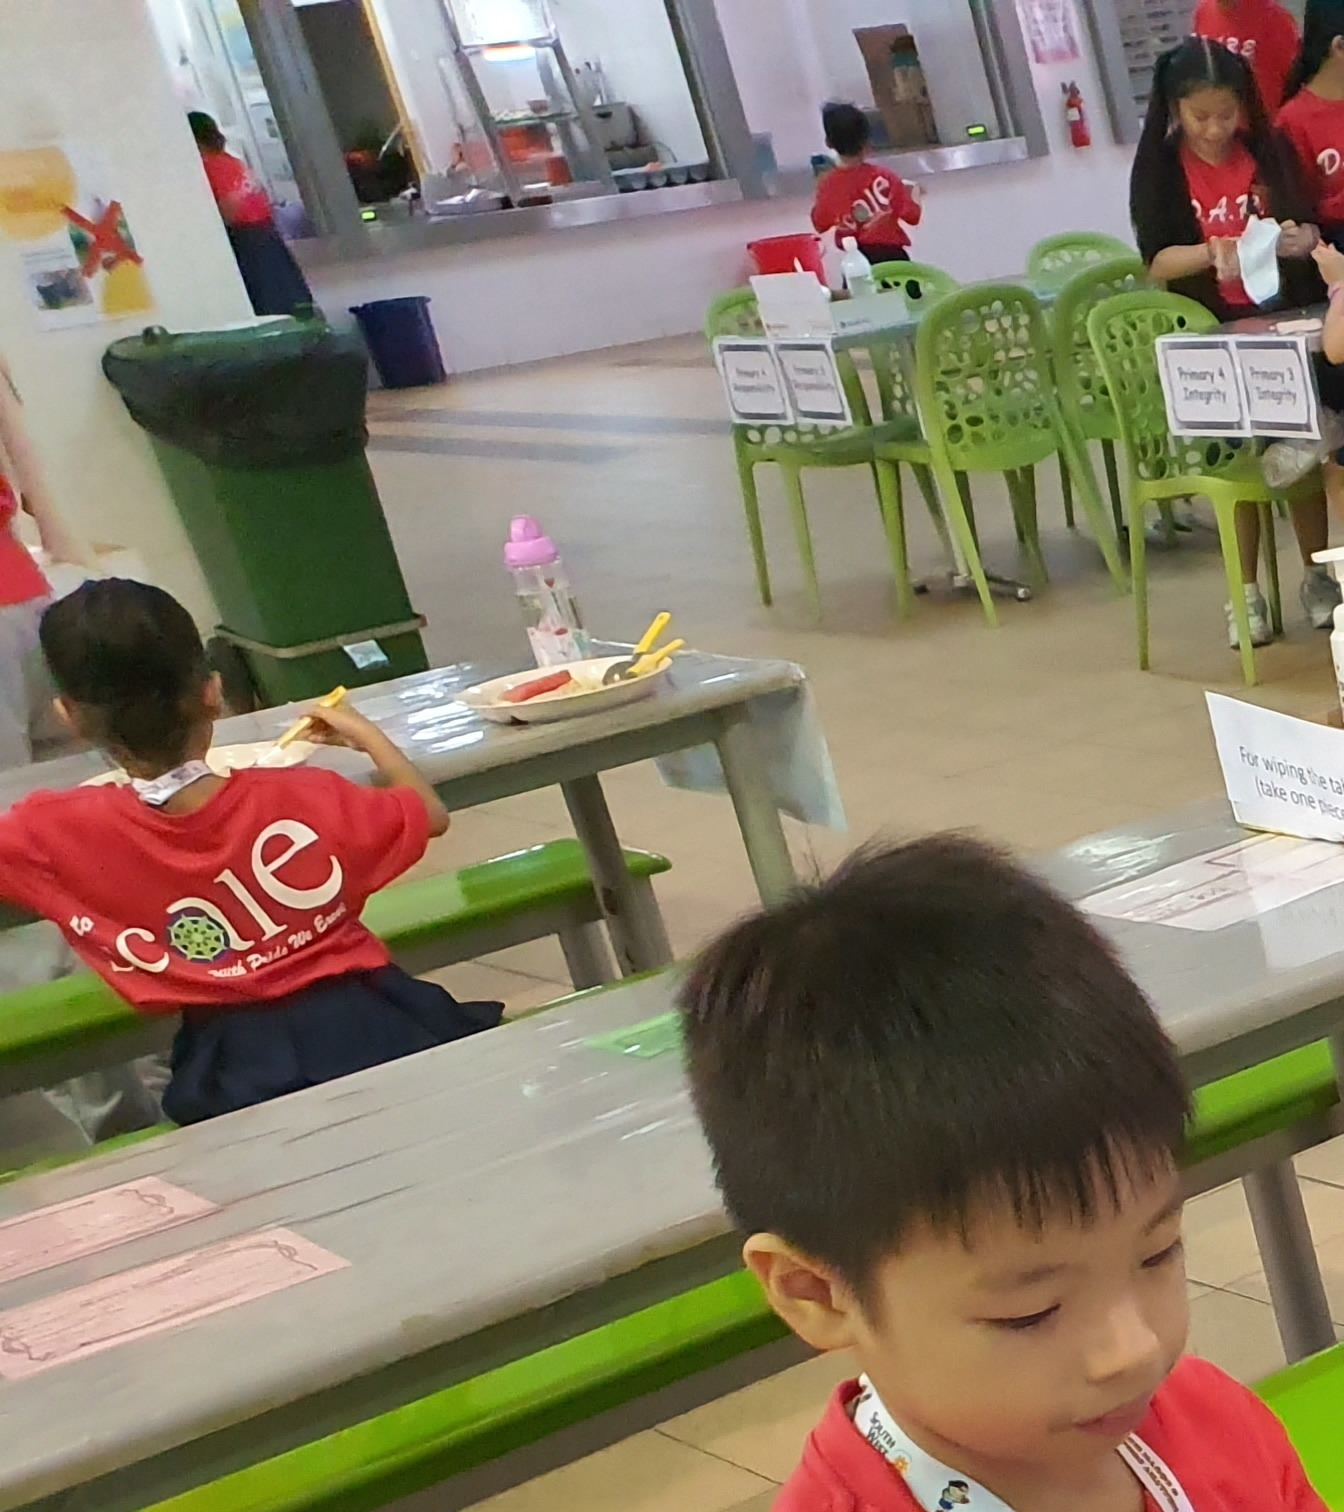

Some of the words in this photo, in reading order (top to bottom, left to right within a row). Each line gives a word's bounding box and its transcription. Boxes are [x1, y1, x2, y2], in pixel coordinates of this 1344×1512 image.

[1177, 366, 1215, 384] Primary
[1249, 366, 1285, 384] Primary
[1183, 386, 1227, 405] Integrity
[1256, 386, 1297, 405] Integrity
[1238, 746, 1260, 768] For
[1262, 757, 1308, 786] wiping
[1254, 775, 1288, 802] (take
[1290, 790, 1317, 810] one
[869, 1411, 896, 1449] SOUTH
